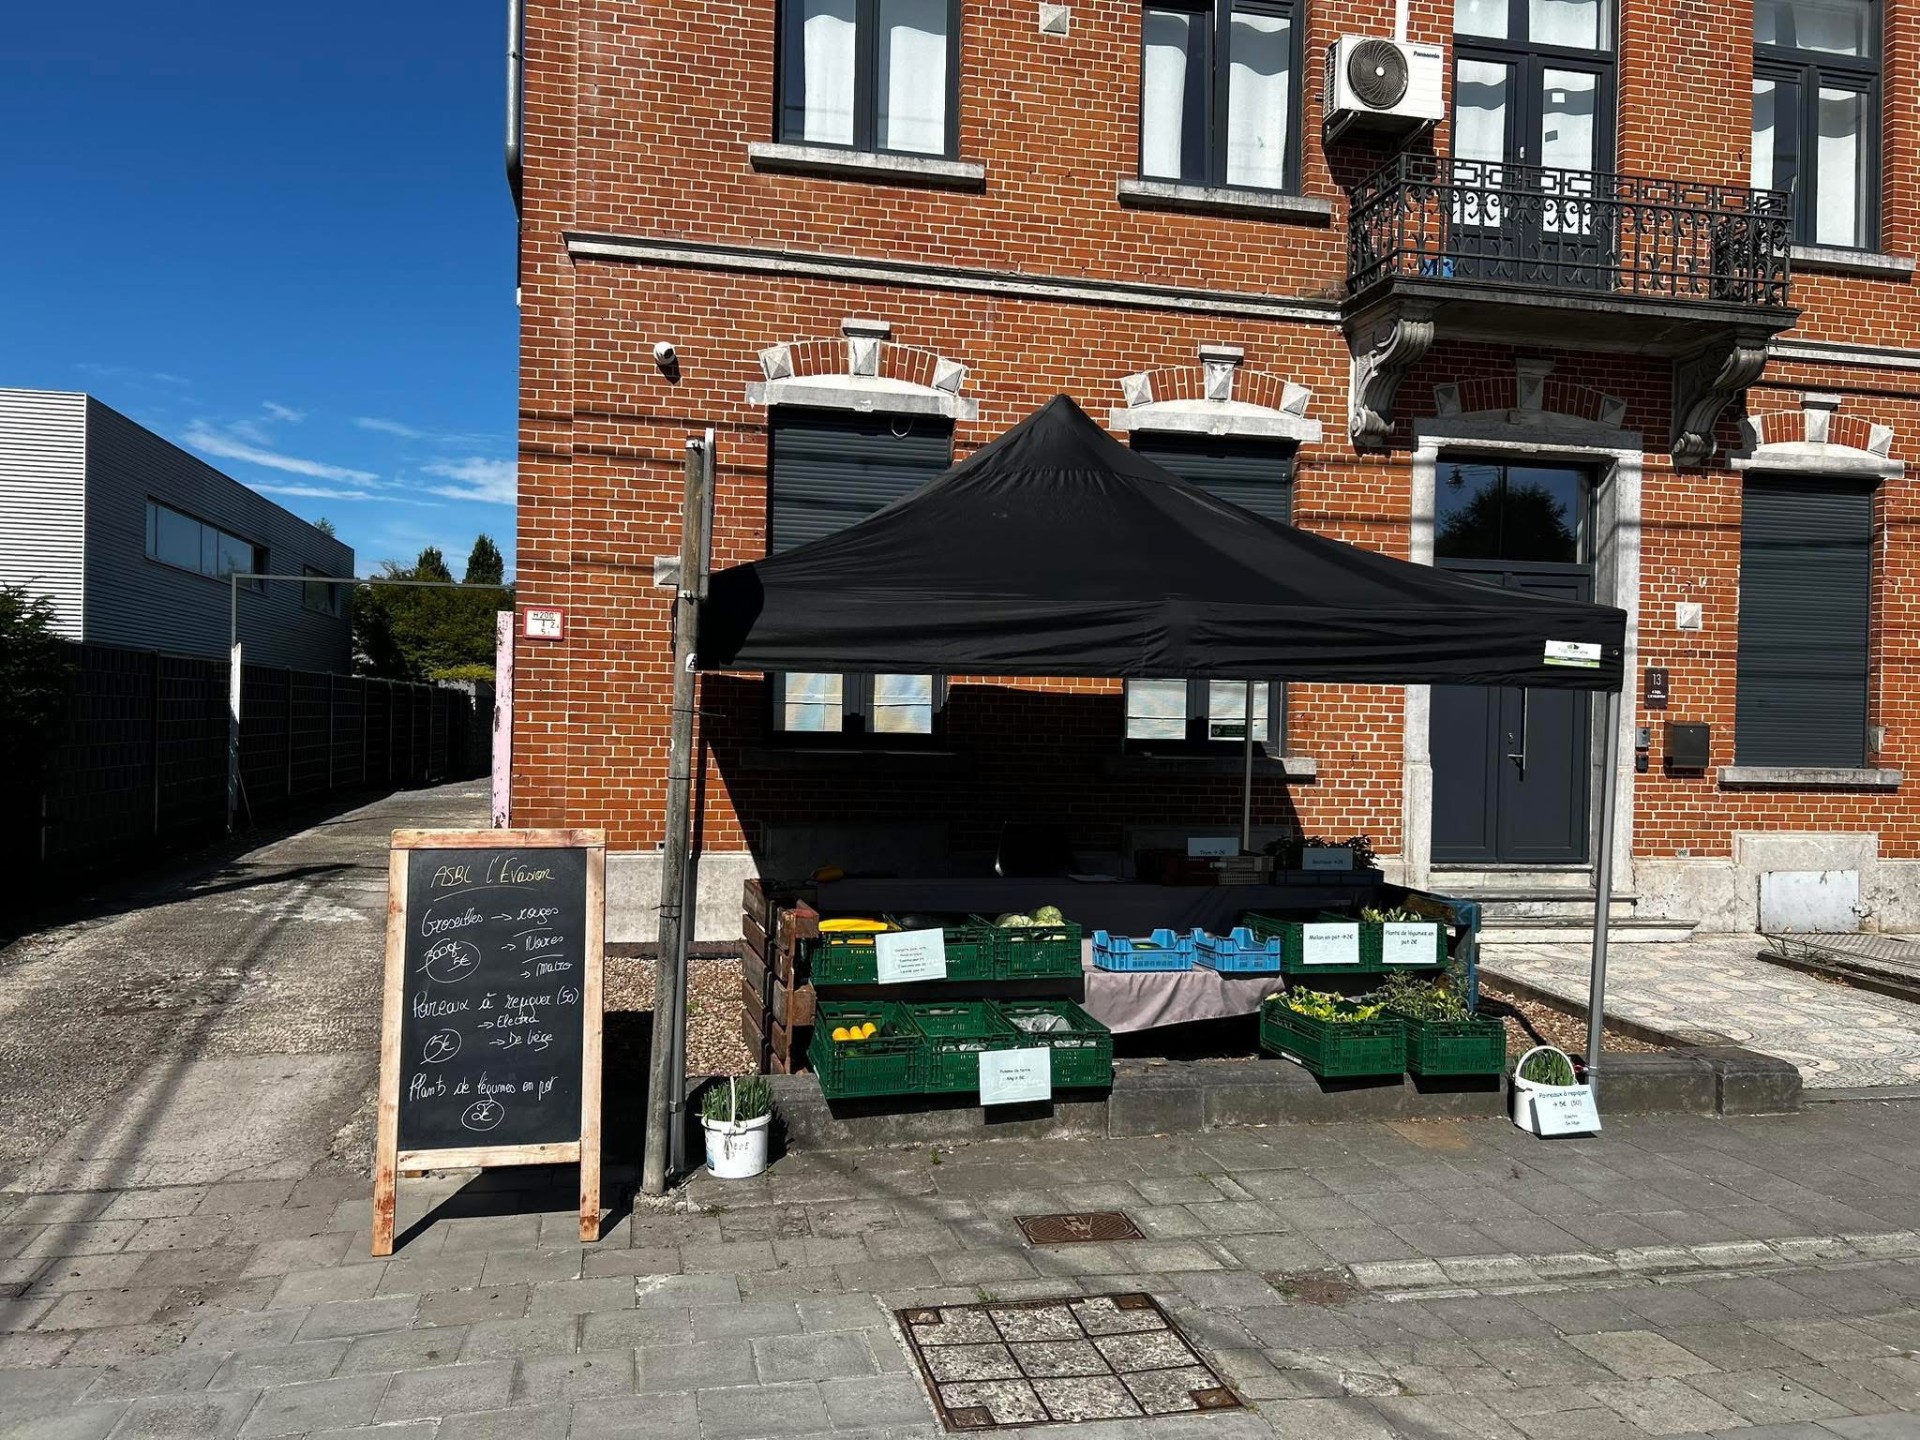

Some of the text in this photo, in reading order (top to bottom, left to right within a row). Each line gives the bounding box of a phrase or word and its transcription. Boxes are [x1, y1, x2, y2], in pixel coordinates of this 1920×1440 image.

[1413, 50, 1440, 59] Panasonic
[1652, 673, 1662, 686] 13
[430, 865, 472, 888] ASBL
[421, 907, 484, 937] Groseilles
